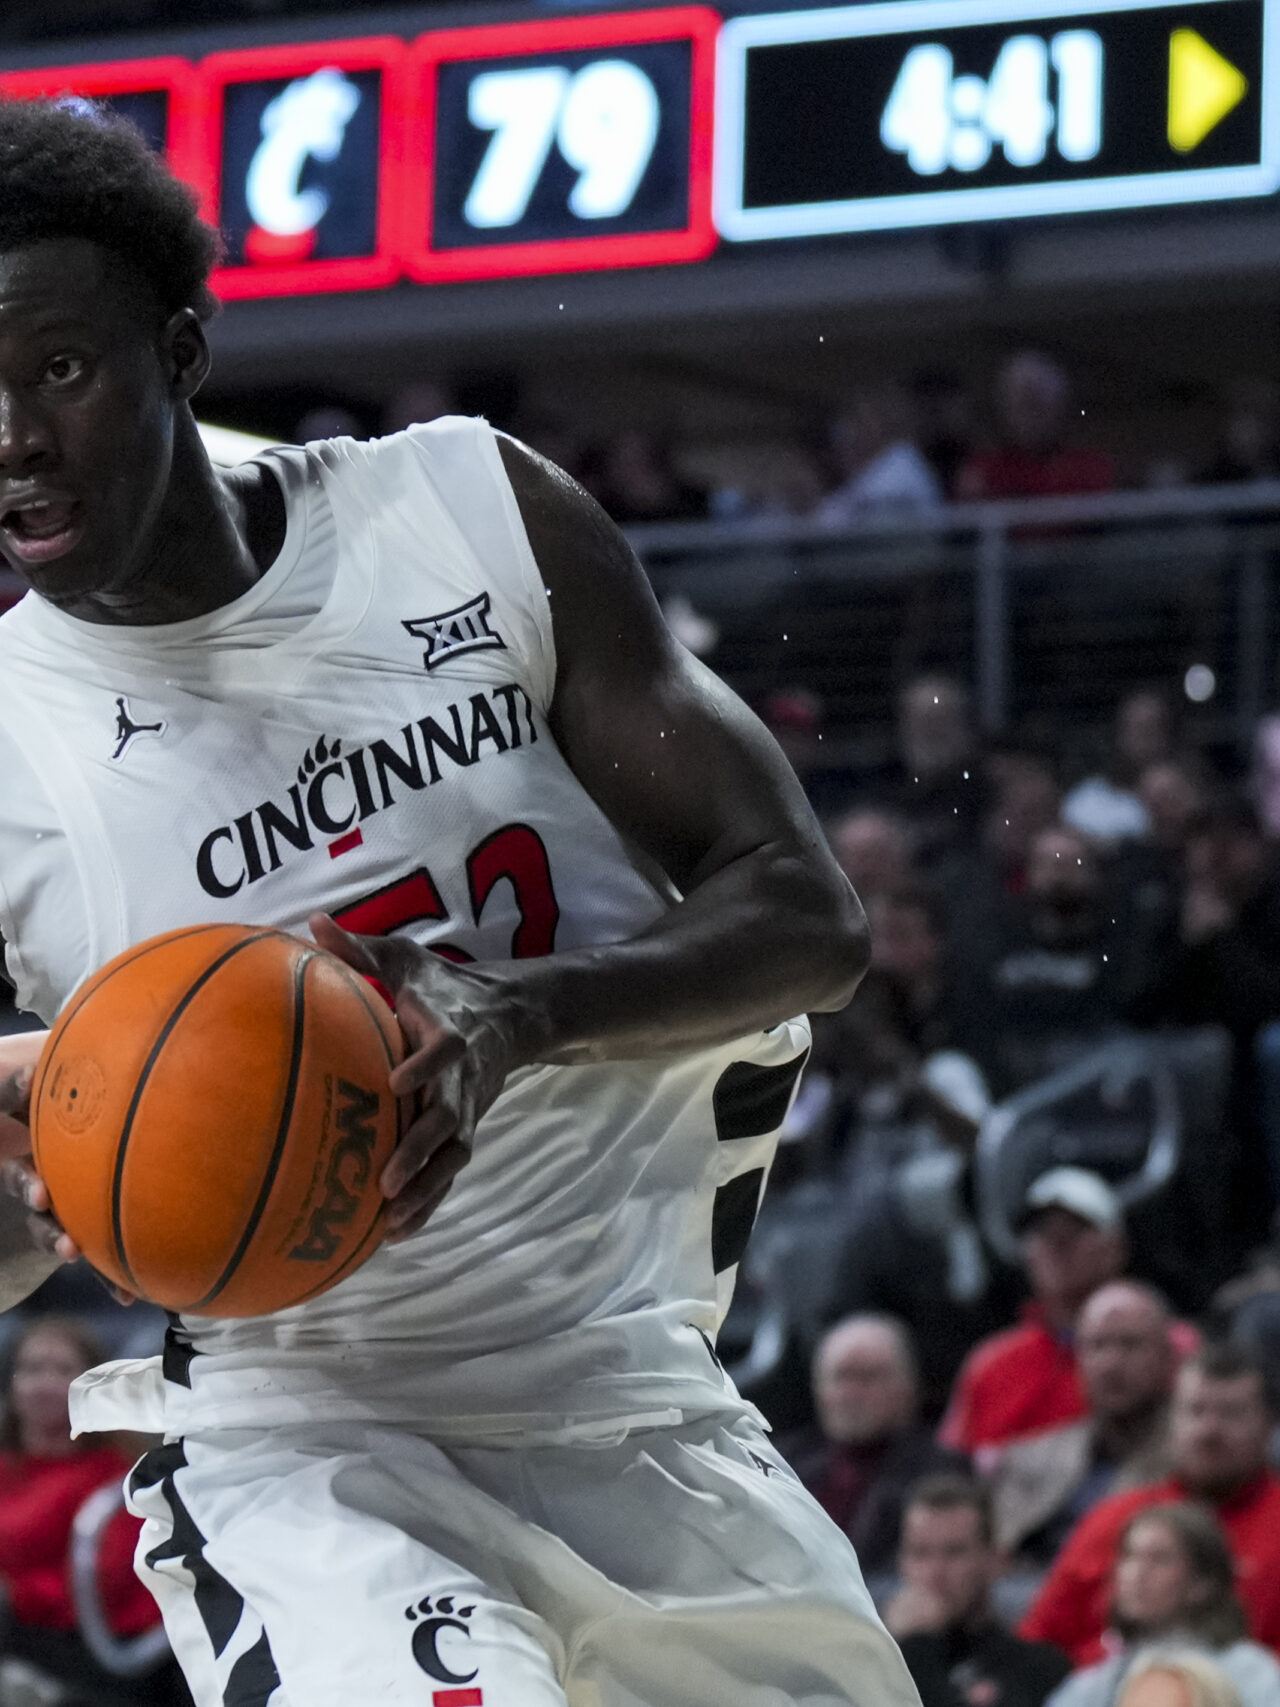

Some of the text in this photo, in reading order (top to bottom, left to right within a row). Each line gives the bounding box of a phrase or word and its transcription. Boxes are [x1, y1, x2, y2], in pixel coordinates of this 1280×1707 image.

[464, 59, 661, 229] 79
[881, 29, 1105, 177] 4:41
[287, 1077, 380, 1262] NCAA
